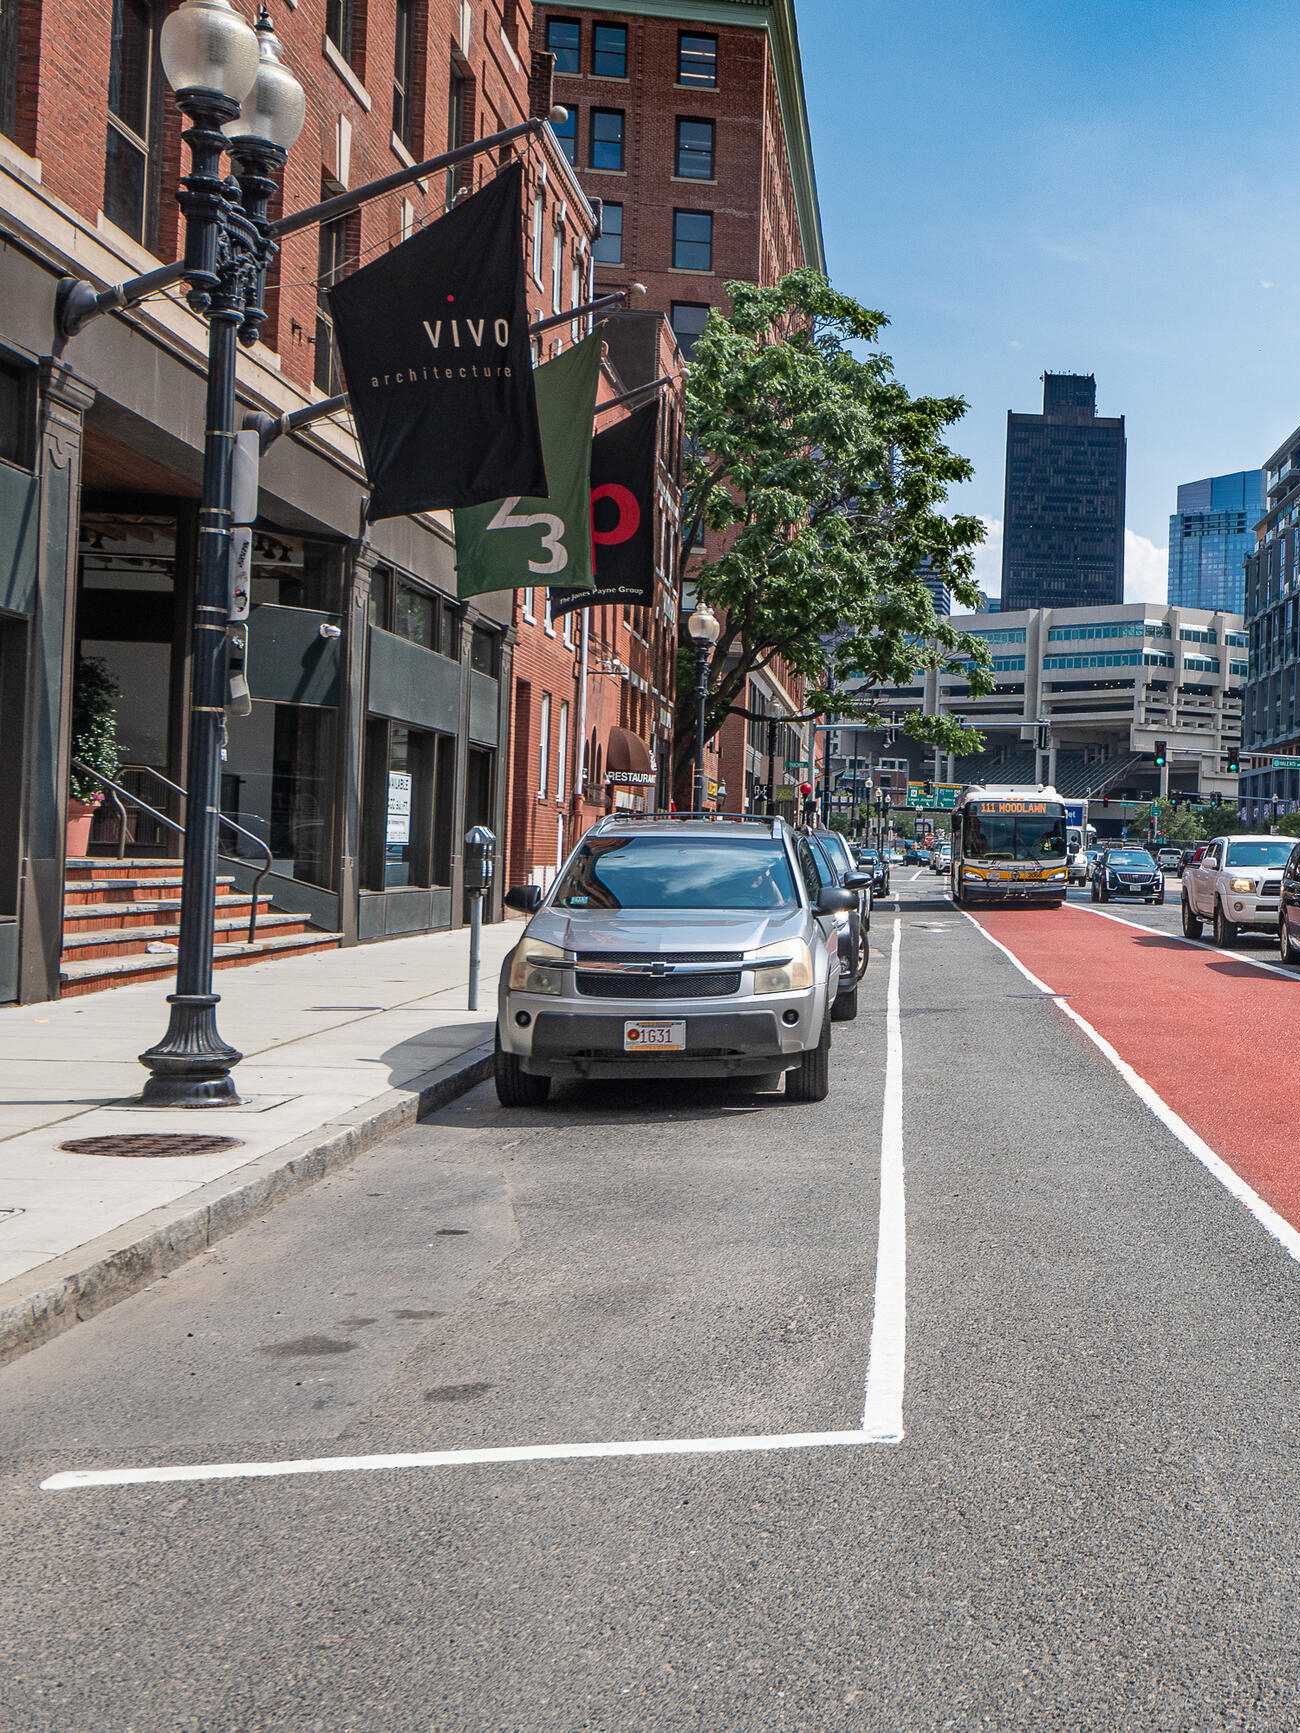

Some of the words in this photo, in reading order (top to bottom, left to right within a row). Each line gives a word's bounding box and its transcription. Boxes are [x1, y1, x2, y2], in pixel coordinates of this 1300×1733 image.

[422, 318, 509, 349] VIVO
[371, 365, 512, 388] architecture
[618, 585, 644, 596] Group
[980, 802, 996, 813] 111
[998, 802, 1047, 813] WOODLAWN
[639, 1028, 673, 1044] 1G31
